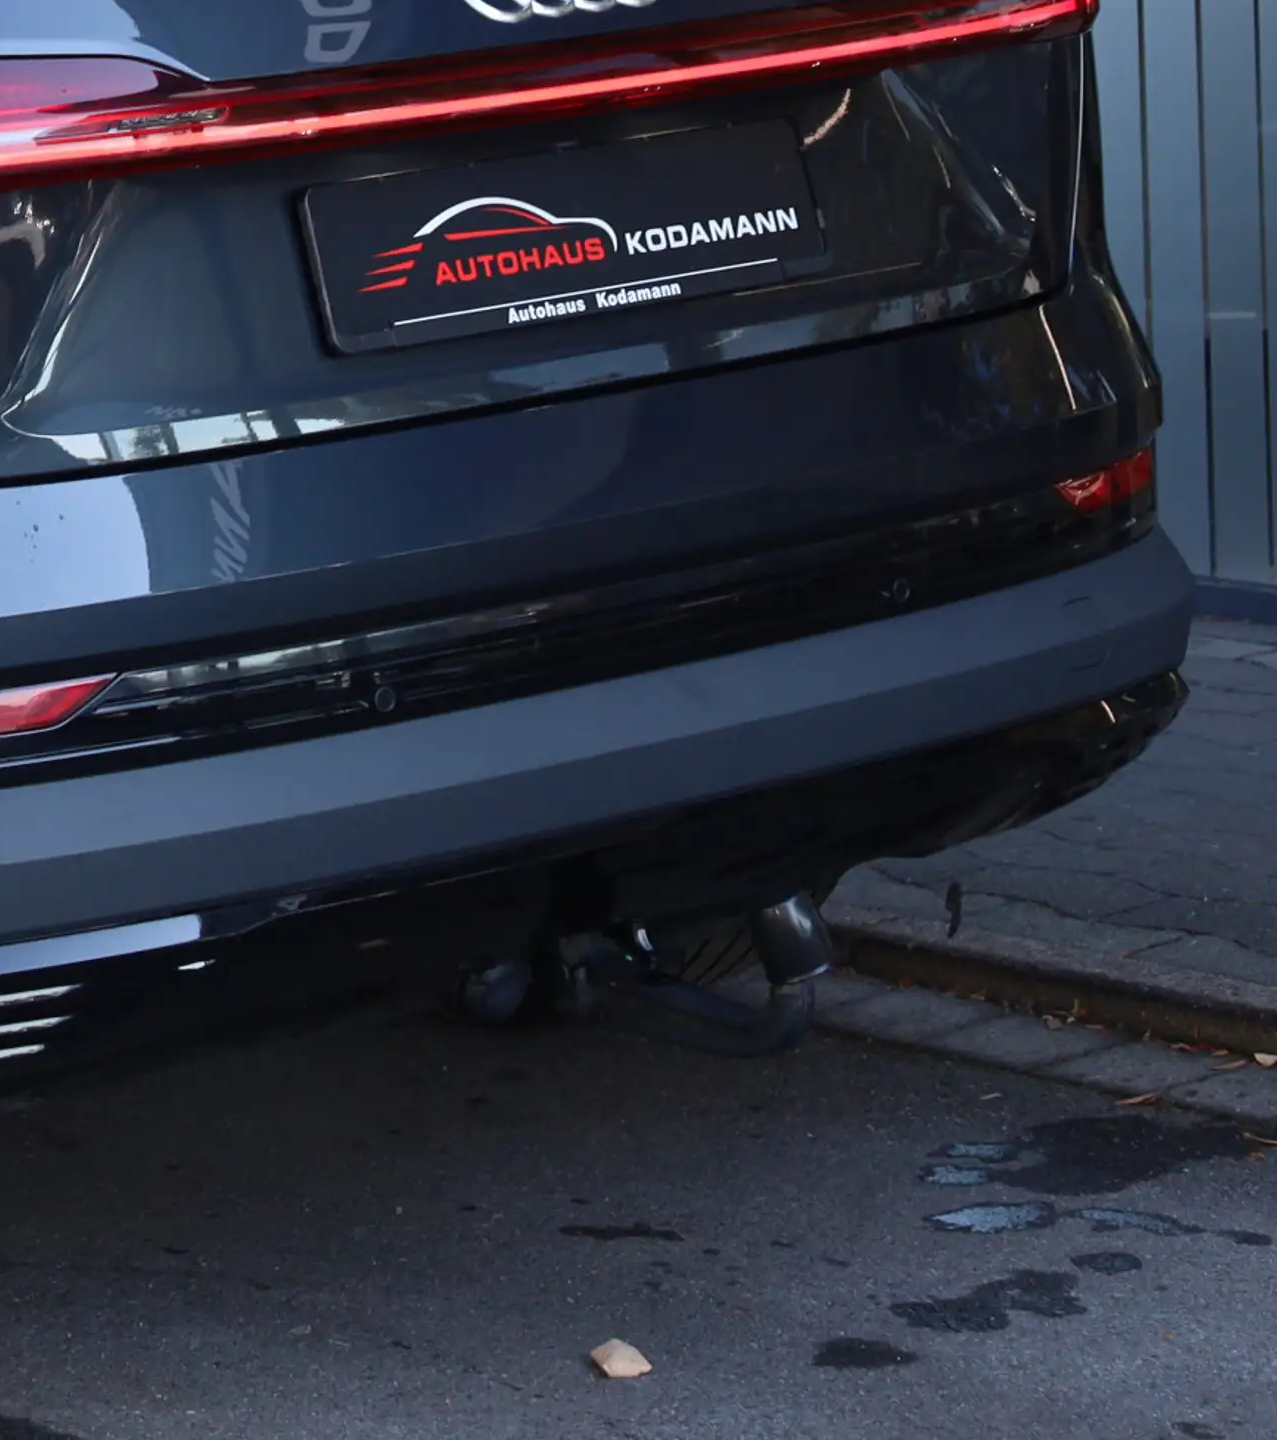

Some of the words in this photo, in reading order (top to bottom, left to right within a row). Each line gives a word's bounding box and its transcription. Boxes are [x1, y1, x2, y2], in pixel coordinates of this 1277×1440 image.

[434, 237, 606, 287] AUTOHAUS
[625, 207, 799, 256] KODAMANN
[507, 296, 586, 325] Autohaus
[596, 280, 682, 310] Kodamann
